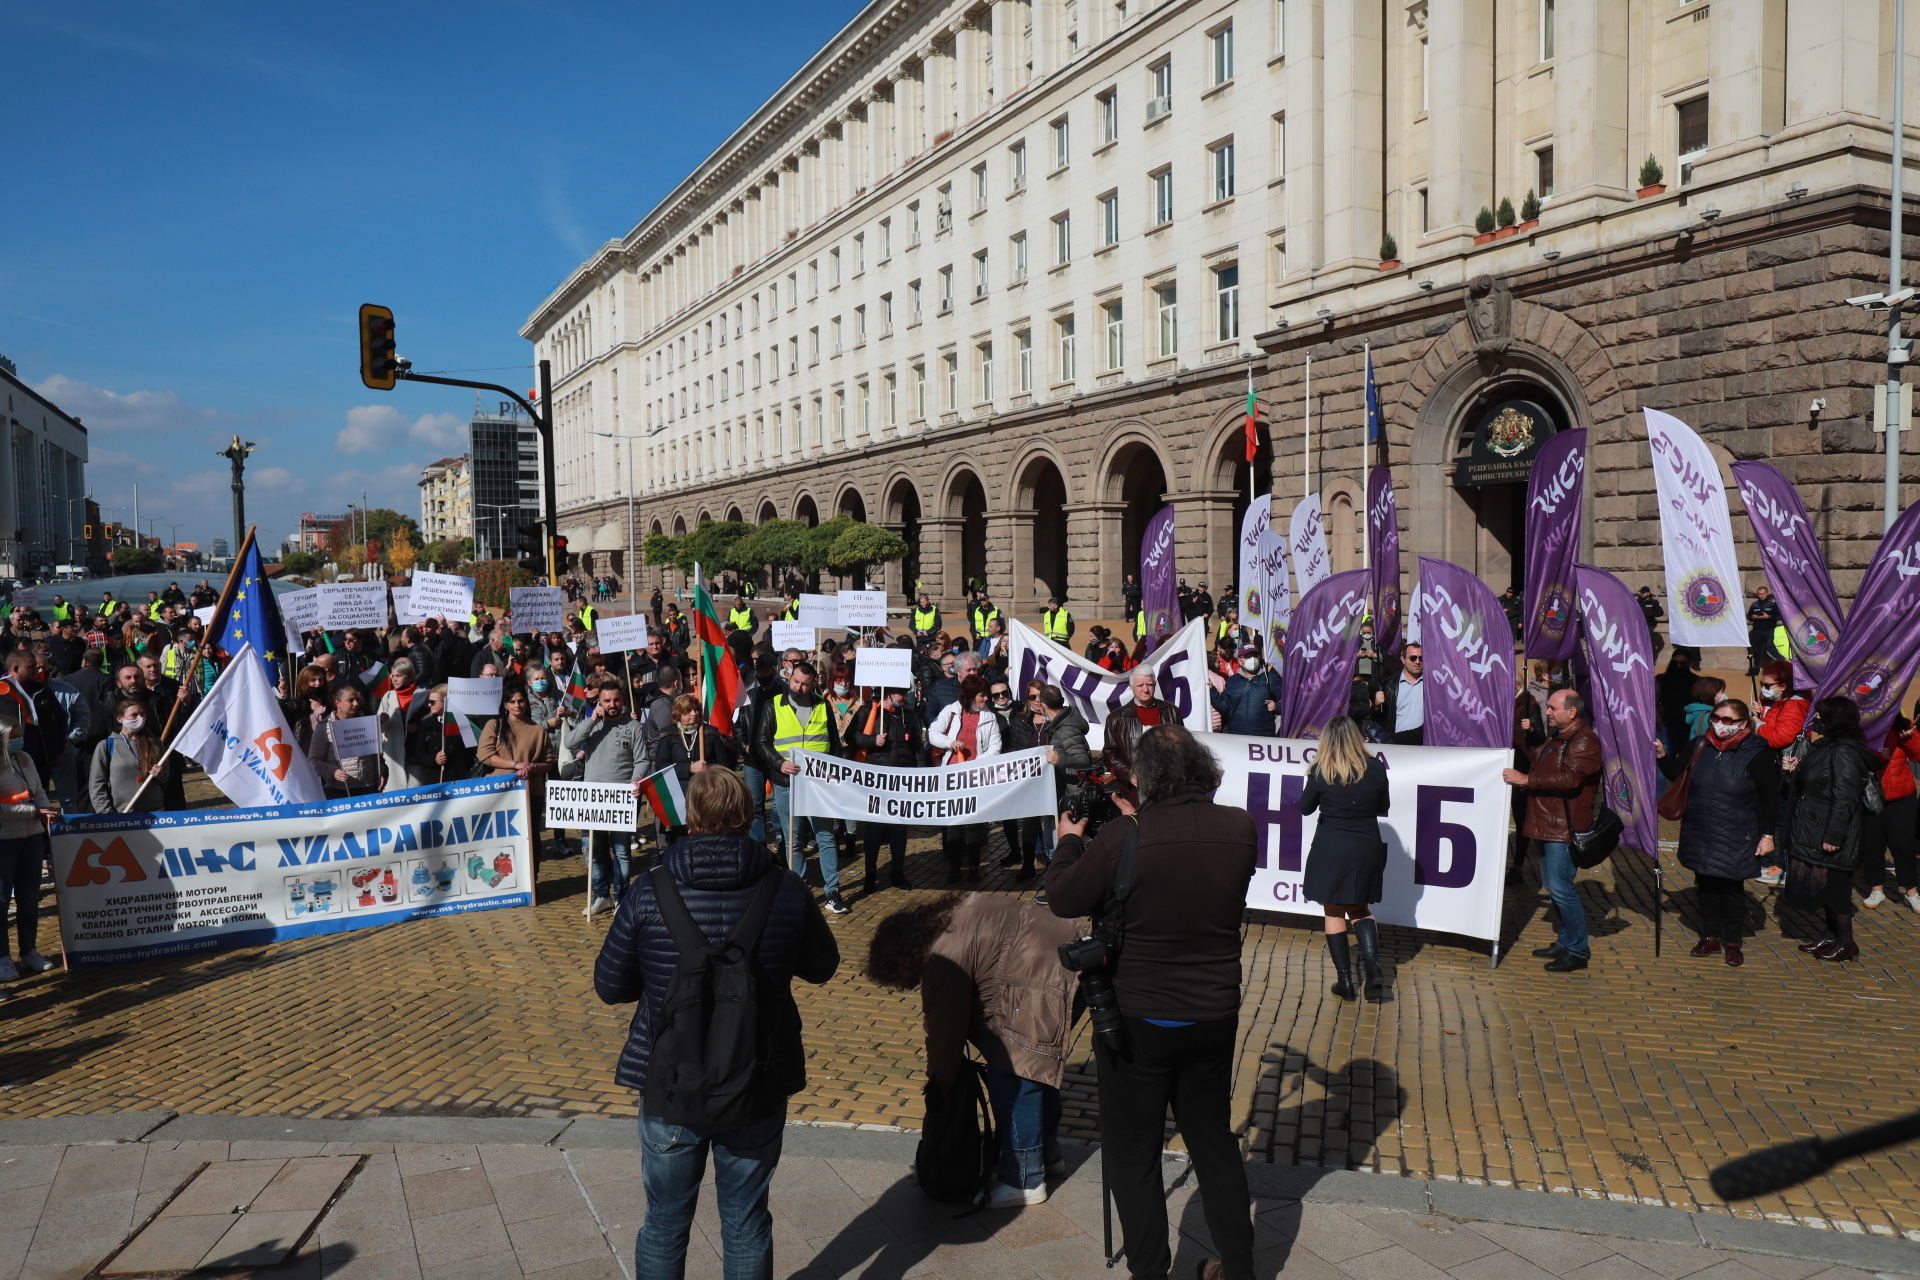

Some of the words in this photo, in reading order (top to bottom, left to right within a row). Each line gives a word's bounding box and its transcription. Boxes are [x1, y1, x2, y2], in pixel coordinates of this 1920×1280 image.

[1468, 462, 1513, 472] РЕПУБЛИКА
[1514, 460, 1534, 468] БЪЛГ
[1472, 470, 1525, 481] МИНИСТЕРСКИ
[421, 577, 447, 585] ИСКАМЕ
[322, 585, 382, 594] СВРЪХПЕЧАЛБИТЕ
[421, 586, 453, 594] РЕШЕНИЯ
[419, 595, 463, 605] ПРОБЛЕМИТЕ
[296, 602, 319, 611] ДОСТО
[332, 606, 376, 614] ДОСТАТЪЧНИ
[417, 604, 468, 615] ЕНЕРГЕТИКАТА!
[840, 603, 884, 612] енергийното
[290, 613, 313, 622] ИСКАМЕ
[338, 612, 381, 620] СОЦИАЛНИТЕ
[848, 611, 876, 619] робство!
[804, 756, 940, 793] ХИДРАВЛИЧНИ
[946, 756, 1042, 792] ЕЛЕМЕНТИ
[549, 786, 589, 802] РЕСТОТО
[591, 788, 635, 807] ВЪРНЕТЕ,
[80, 820, 141, 830] Казанлък
[145, 817, 176, 826] 6100,
[184, 815, 201, 825] ул.
[204, 811, 263, 822] Козлодуй,
[266, 810, 279, 818] 68
[298, 808, 323, 816] тел.:
[326, 803, 351, 813] +359
[354, 800, 372, 809] 431
[376, 796, 410, 807] 65167,
[412, 791, 442, 803] факс:
[453, 786, 471, 796] 359
[473, 783, 491, 793] 431
[494, 780, 522, 791] 64114
[868, 794, 880, 815] И
[887, 796, 977, 819] СИСТЕМИ
[550, 806, 575, 822] ТОКА
[578, 808, 633, 825] НАМАЛЕТЕ!
[277, 808, 521, 868] ХИДРАВЛИК
[106, 891, 183, 907] ХИДРАВЛИЧНИ
[186, 886, 227, 898] МОТОРИ
[76, 903, 163, 919] ХИДРОСТАТИЧНИ
[165, 892, 263, 910] СЕРВОУПРАВЛЕНИЯ
[412, 896, 522, 917] www.ms-hydraulic.com
[82, 918, 128, 930] КЛАПАНИ
[137, 911, 191, 925] СПИРАЧКИ
[200, 903, 258, 917] АКСЕСОАРИ
[74, 930, 124, 941] АКСИАЛНО
[126, 924, 174, 937] БУТАЛНИ
[177, 918, 219, 931] МОТОРИ
[221, 917, 228, 925] И
[231, 912, 266, 923] ПОМПИ
[81, 939, 218, 963] msh@ms-hydraulic.com
